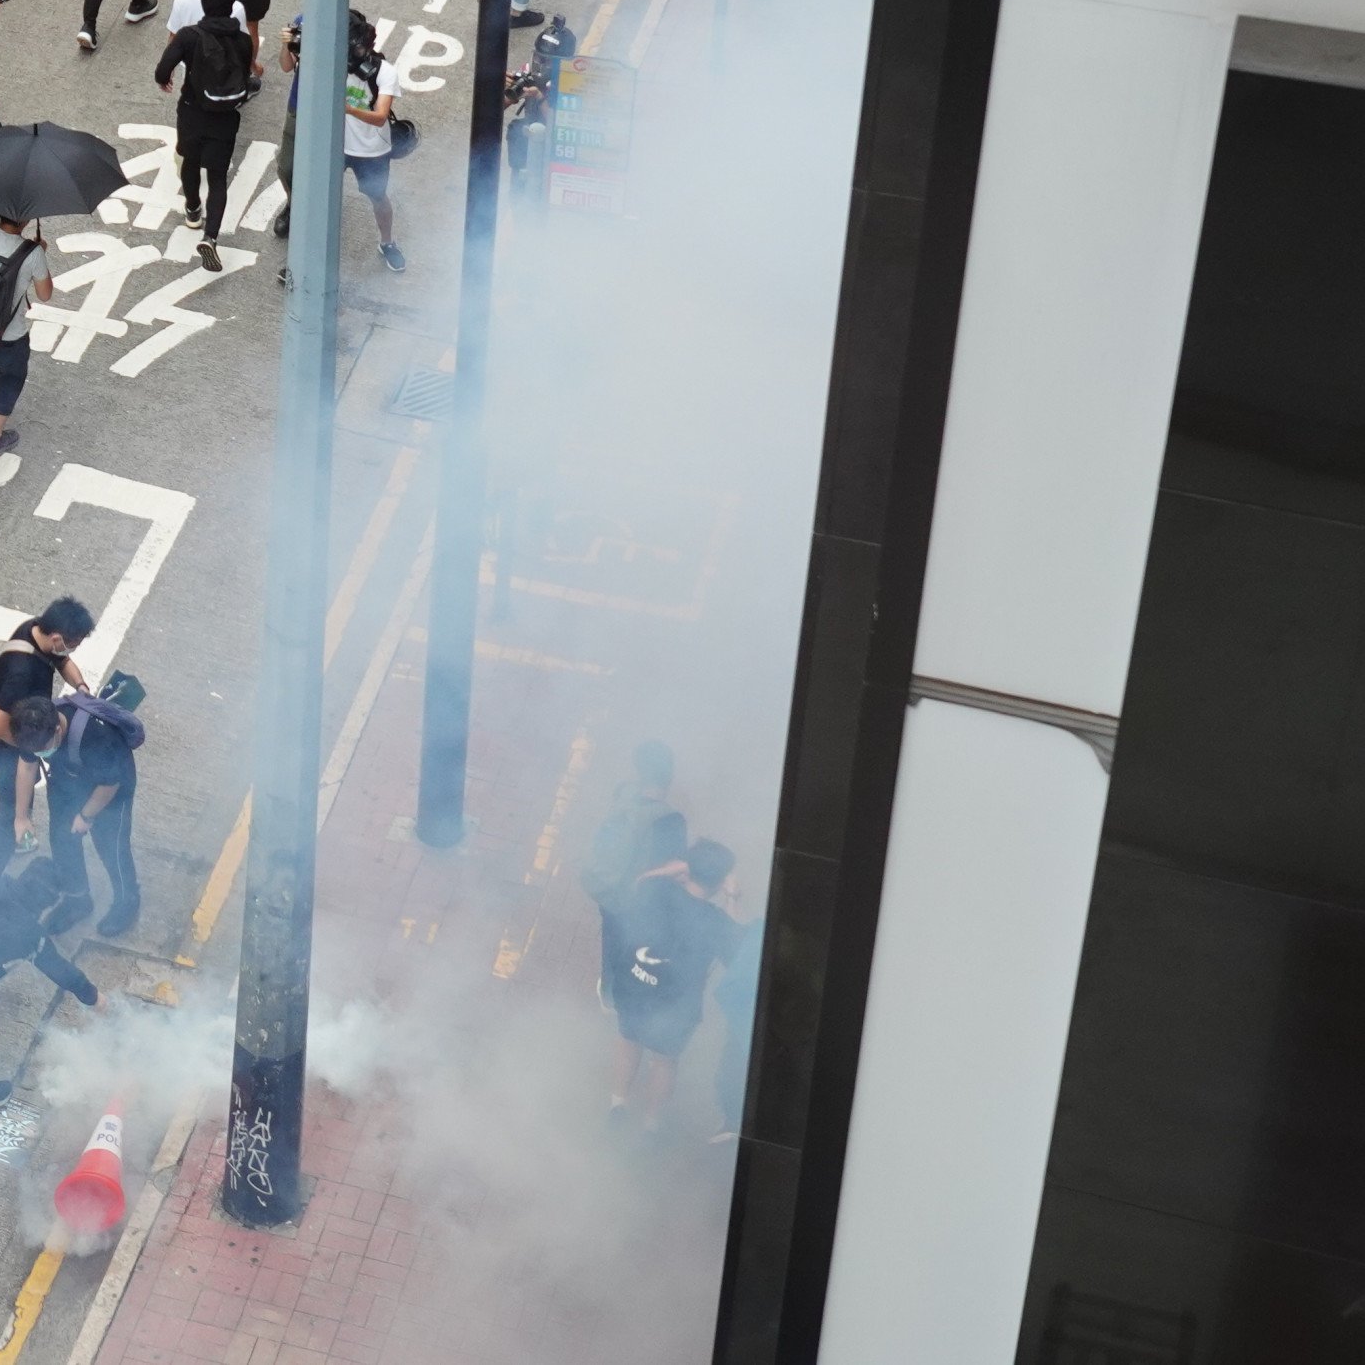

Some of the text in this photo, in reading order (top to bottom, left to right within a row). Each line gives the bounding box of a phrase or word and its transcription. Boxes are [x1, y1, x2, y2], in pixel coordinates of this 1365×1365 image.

[561, 95, 577, 109] 11
[556, 128, 576, 142] E11
[555, 145, 576, 158] 5B
[97, 1132, 121, 1148] POL
